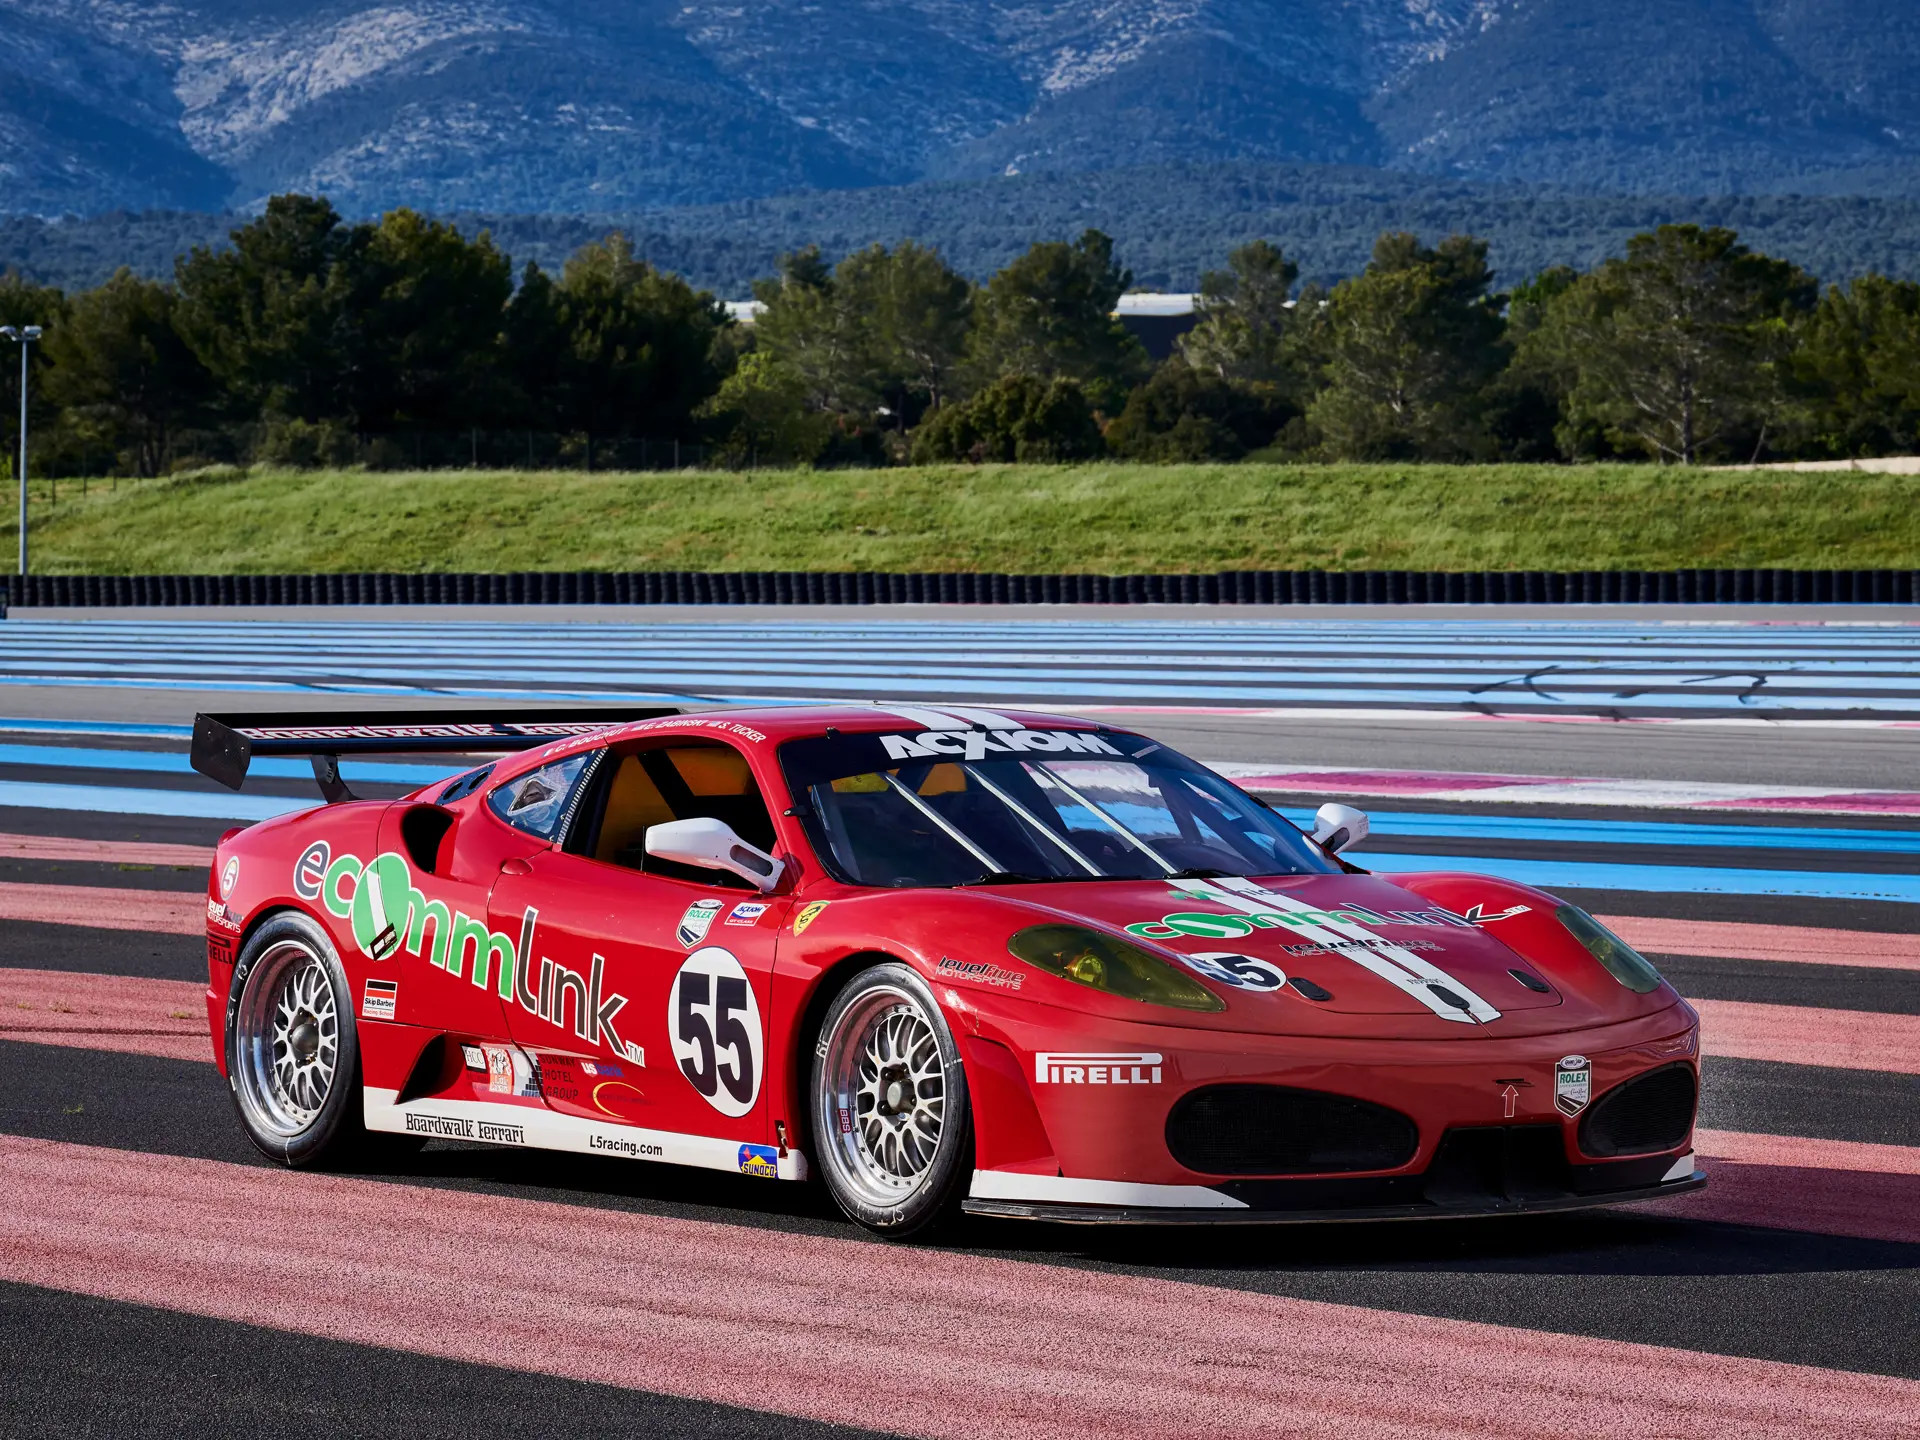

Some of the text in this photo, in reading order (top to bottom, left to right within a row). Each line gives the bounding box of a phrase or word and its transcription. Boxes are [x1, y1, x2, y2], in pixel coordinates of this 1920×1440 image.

[243, 722, 620, 741] Boardwalk Ferr
[729, 723, 767, 743] TUCKER
[878, 730, 1124, 761] ACXIOM
[687, 909, 714, 919] ROLEX
[936, 968, 1022, 991] MOTORSPORTS
[364, 998, 395, 1008] Skip Barber
[679, 971, 754, 1104] 55
[541, 1055, 576, 1067] SUNWAY
[1035, 1052, 1163, 1084] PIRELLI
[544, 1069, 574, 1083] HOTEL
[1560, 1072, 1587, 1084] ROLEX
[545, 1085, 579, 1101] GROUP
[405, 1112, 525, 1144] Boardwalk Ferrari
[840, 1109, 852, 1131] BBS
[589, 1134, 663, 1156] L5racing.com
[743, 1162, 776, 1178] SUNOCO
